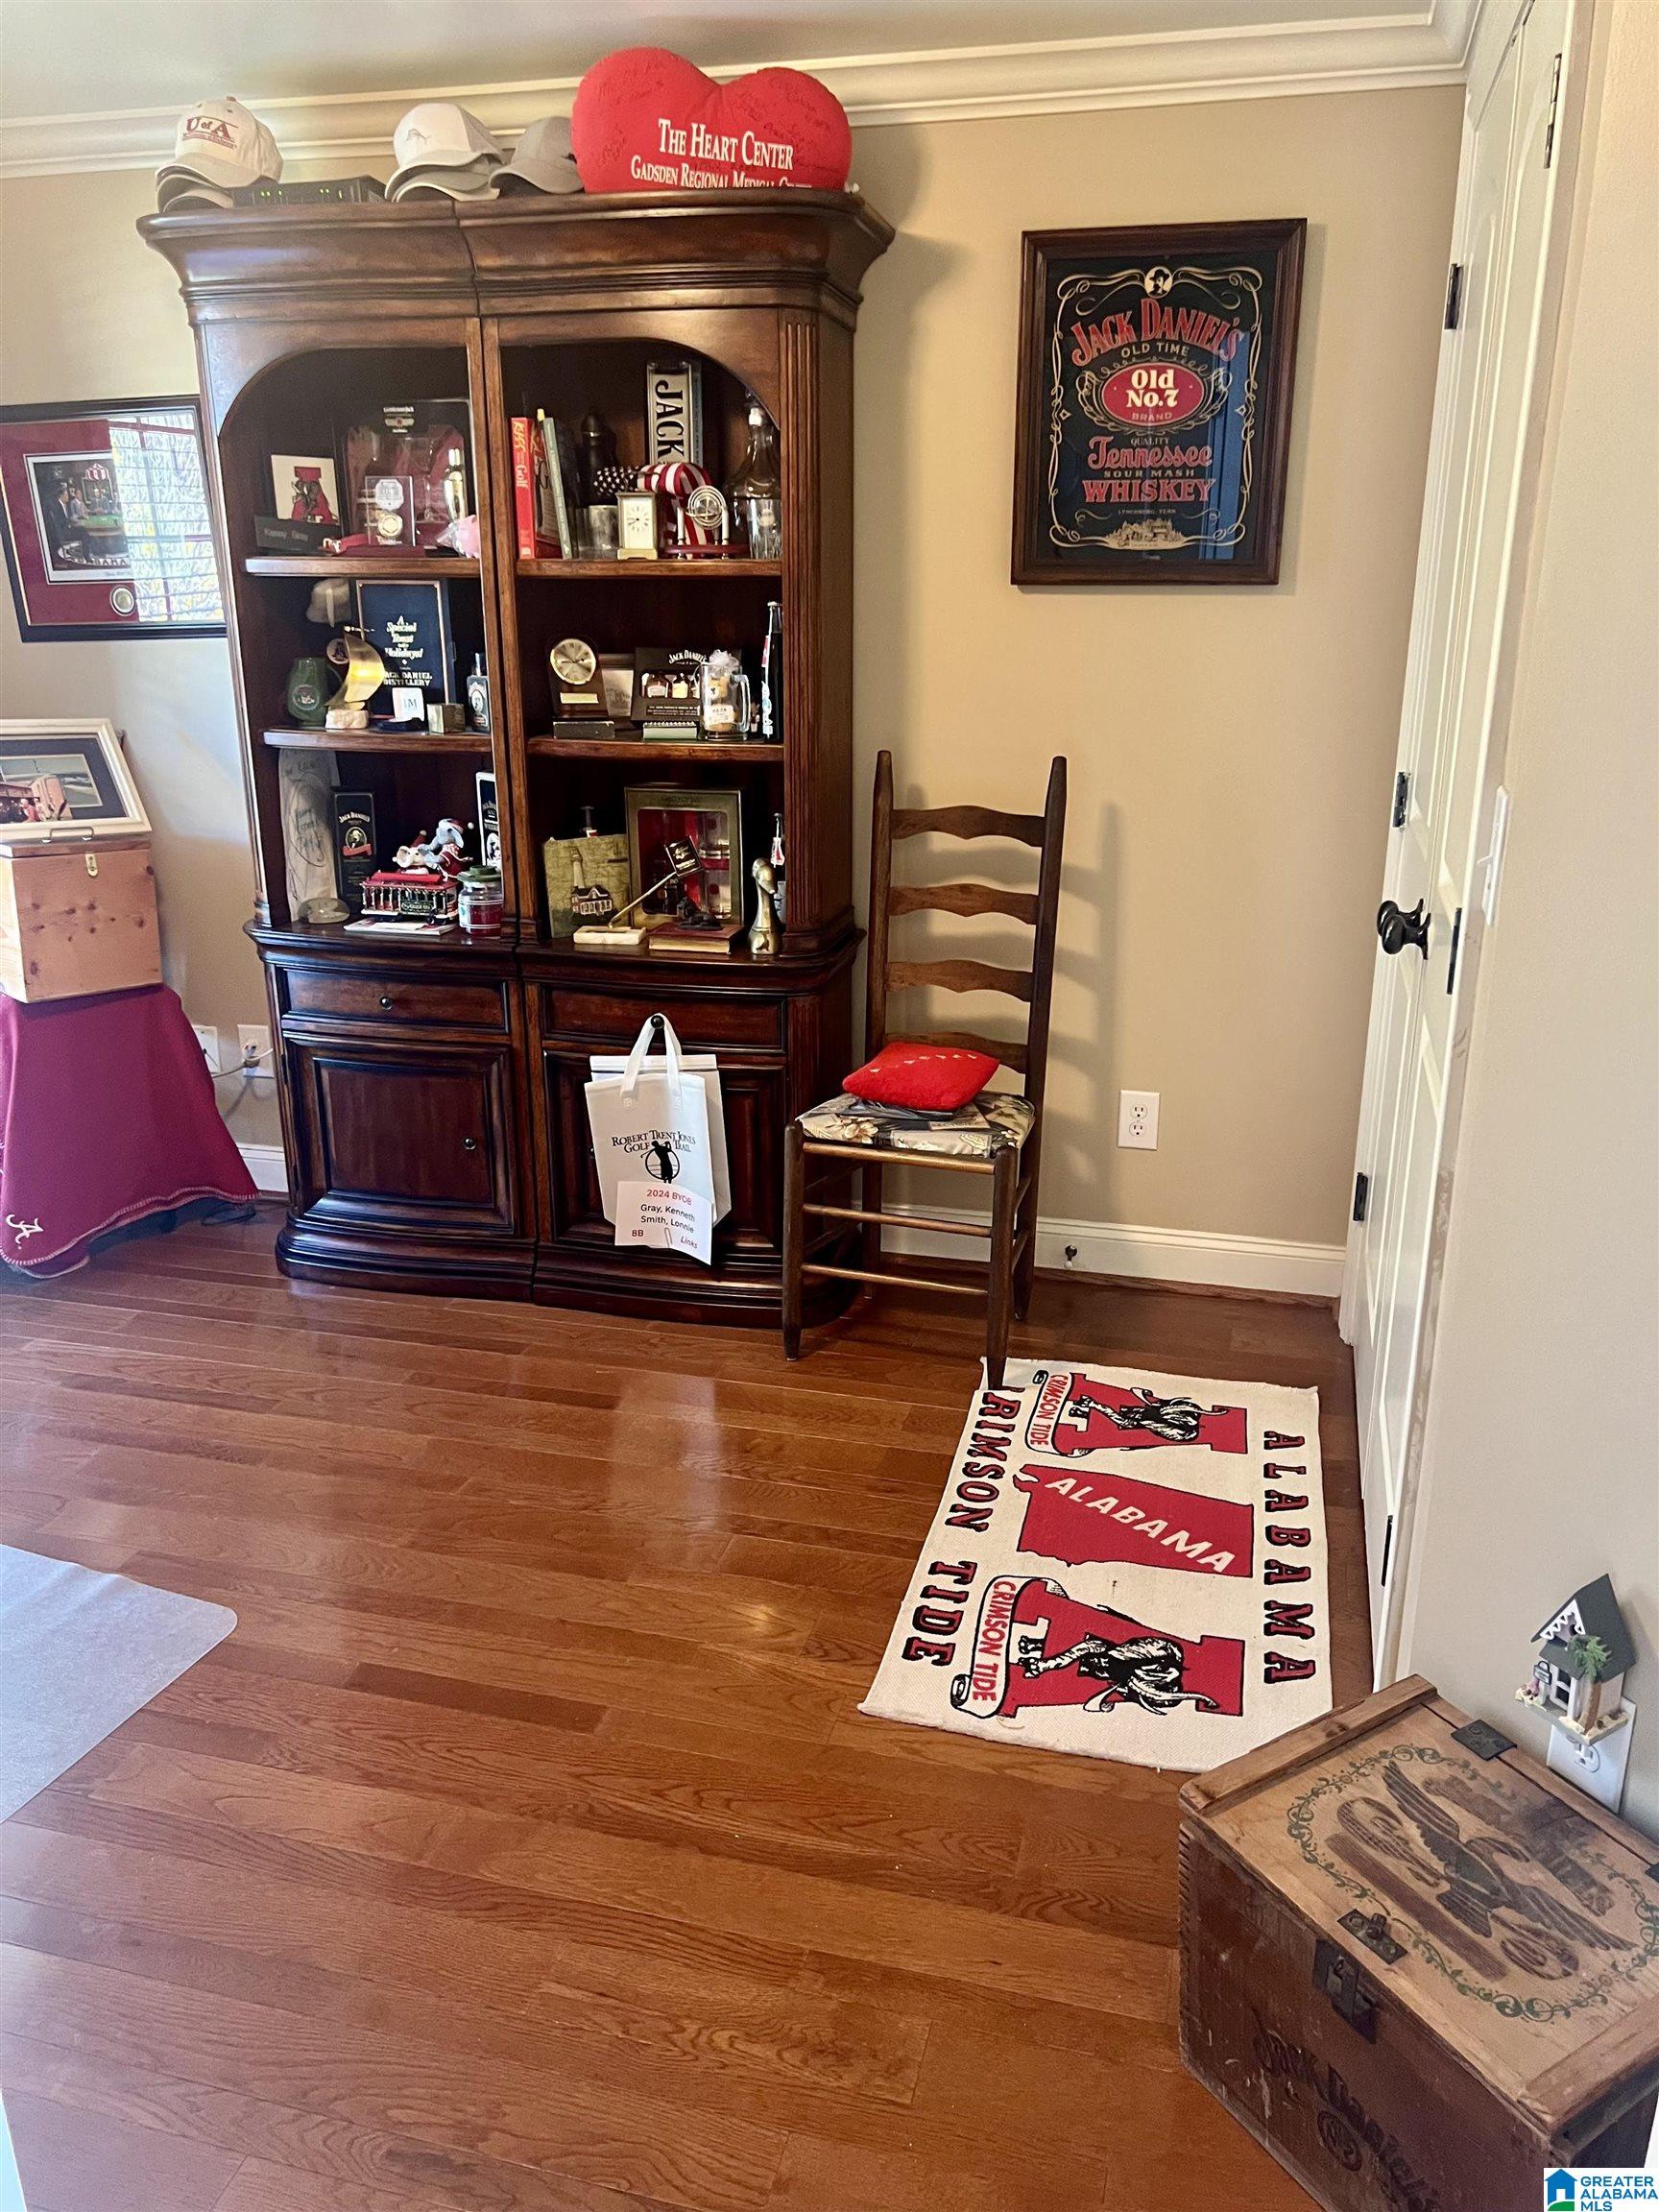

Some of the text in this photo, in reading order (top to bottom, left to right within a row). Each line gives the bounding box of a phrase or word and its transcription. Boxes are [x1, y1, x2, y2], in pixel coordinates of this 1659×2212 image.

[658, 117, 794, 171] THE HEART CENTER
[631, 155, 679, 186] GADSDEN
[1070, 298, 1245, 367] JACK DANIEL'S
[1120, 342, 1190, 358] OLD TIME
[1131, 369, 1175, 390] Old
[1125, 389, 1179, 408] No.7
[655, 379, 685, 459] JACK
[1132, 412, 1172, 421] BRAND
[1130, 437, 1169, 447] QUALITY
[1087, 435, 1213, 470] Tennessee
[516, 465, 529, 490] Golf
[1082, 478, 1216, 503] WHISKEY
[668, 653, 685, 664] JACK
[338, 813, 351, 824] JACK
[611, 1129, 697, 1147] ROBERT TRENT JONES
[624, 1140, 691, 1153] GOLF TRAIL
[646, 1190, 670, 1198] 2024
[640, 1203, 696, 1222] Gray, Kenneth
[631, 1229, 644, 1238] 8B
[640, 1214, 695, 1234] Smith, Lonnie
[680, 1236, 698, 1249] Links
[1029, 1374, 1069, 1446] CRIMSON TIDE
[1044, 1477, 1237, 1575] ALABAMA
[1262, 1430, 1317, 1686] ALABAMA
[902, 1560, 978, 1667] TIDE
[972, 1580, 1017, 1702] CRIMSON TIDE
